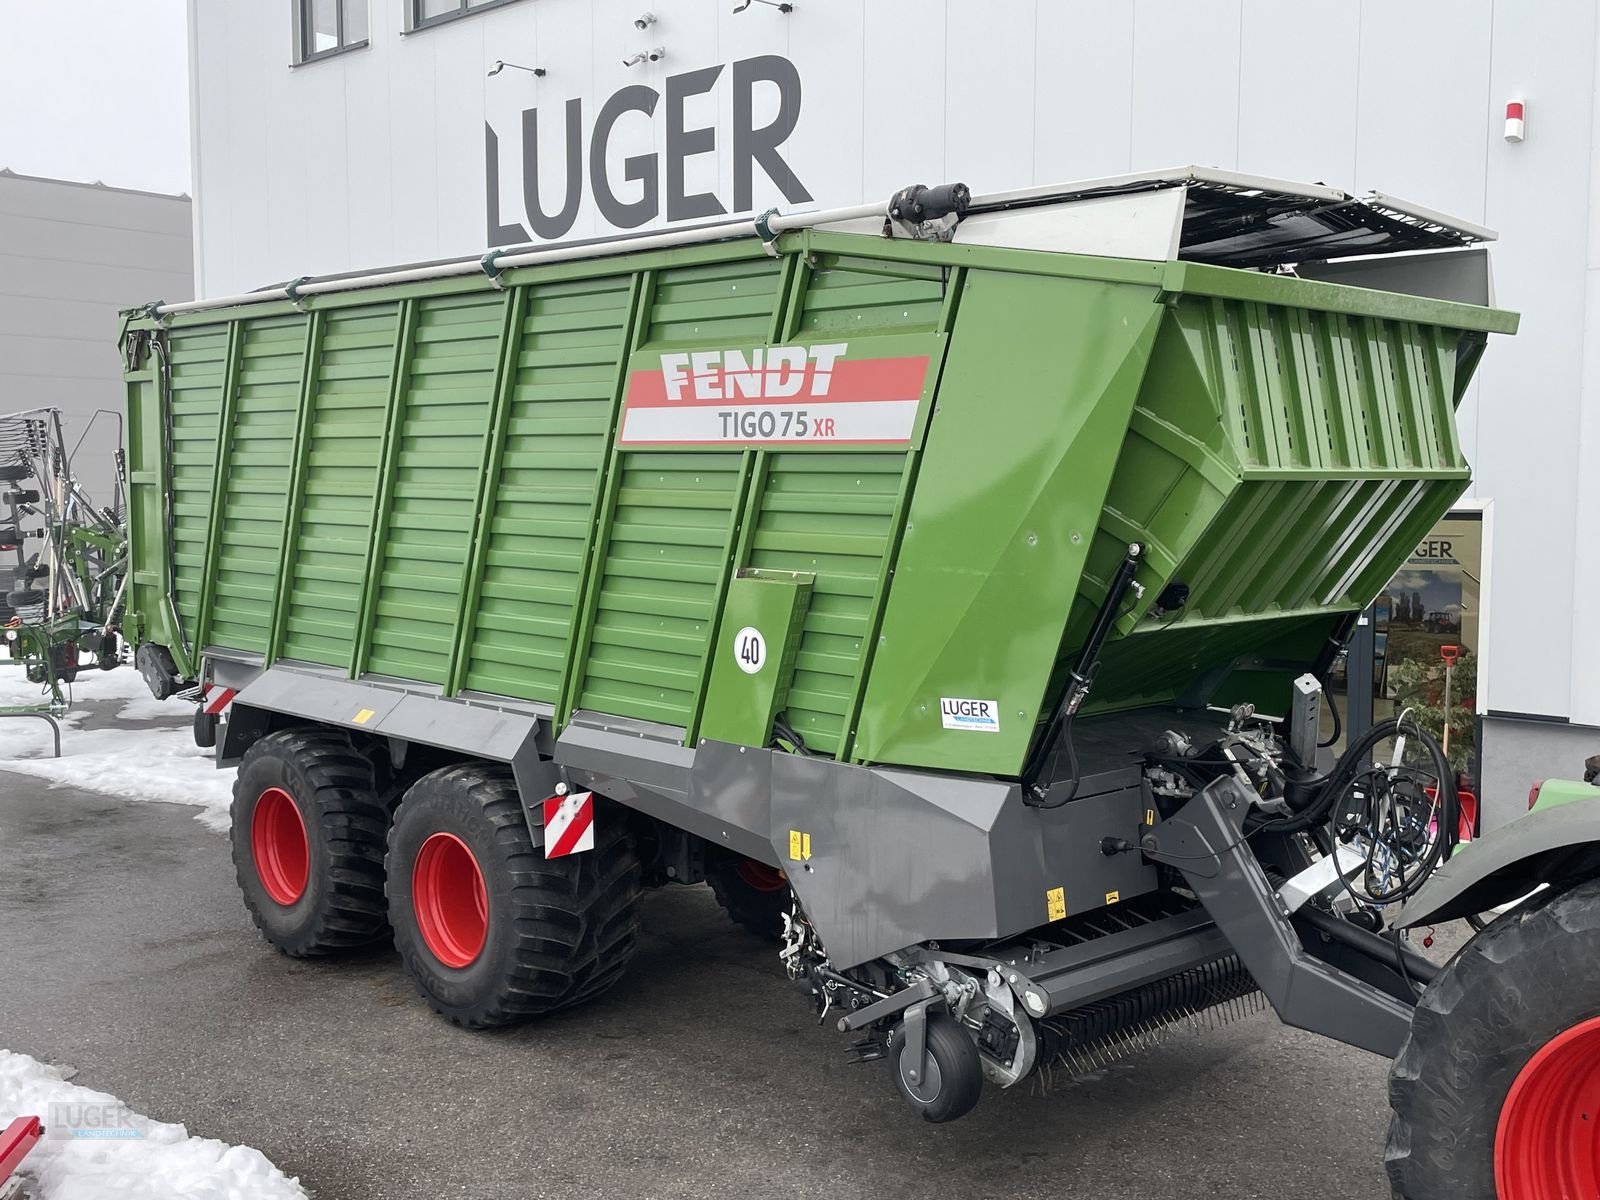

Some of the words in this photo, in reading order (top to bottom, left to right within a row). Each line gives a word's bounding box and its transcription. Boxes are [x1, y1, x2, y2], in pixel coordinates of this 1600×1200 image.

[485, 55, 814, 248] LUGER
[660, 343, 848, 400] FENDT
[718, 411, 776, 438] TIGO
[780, 411, 809, 437] 75
[813, 418, 835, 437] XR
[1415, 541, 1453, 558] GER
[741, 636, 759, 665] 40
[942, 700, 990, 718] LUGER
